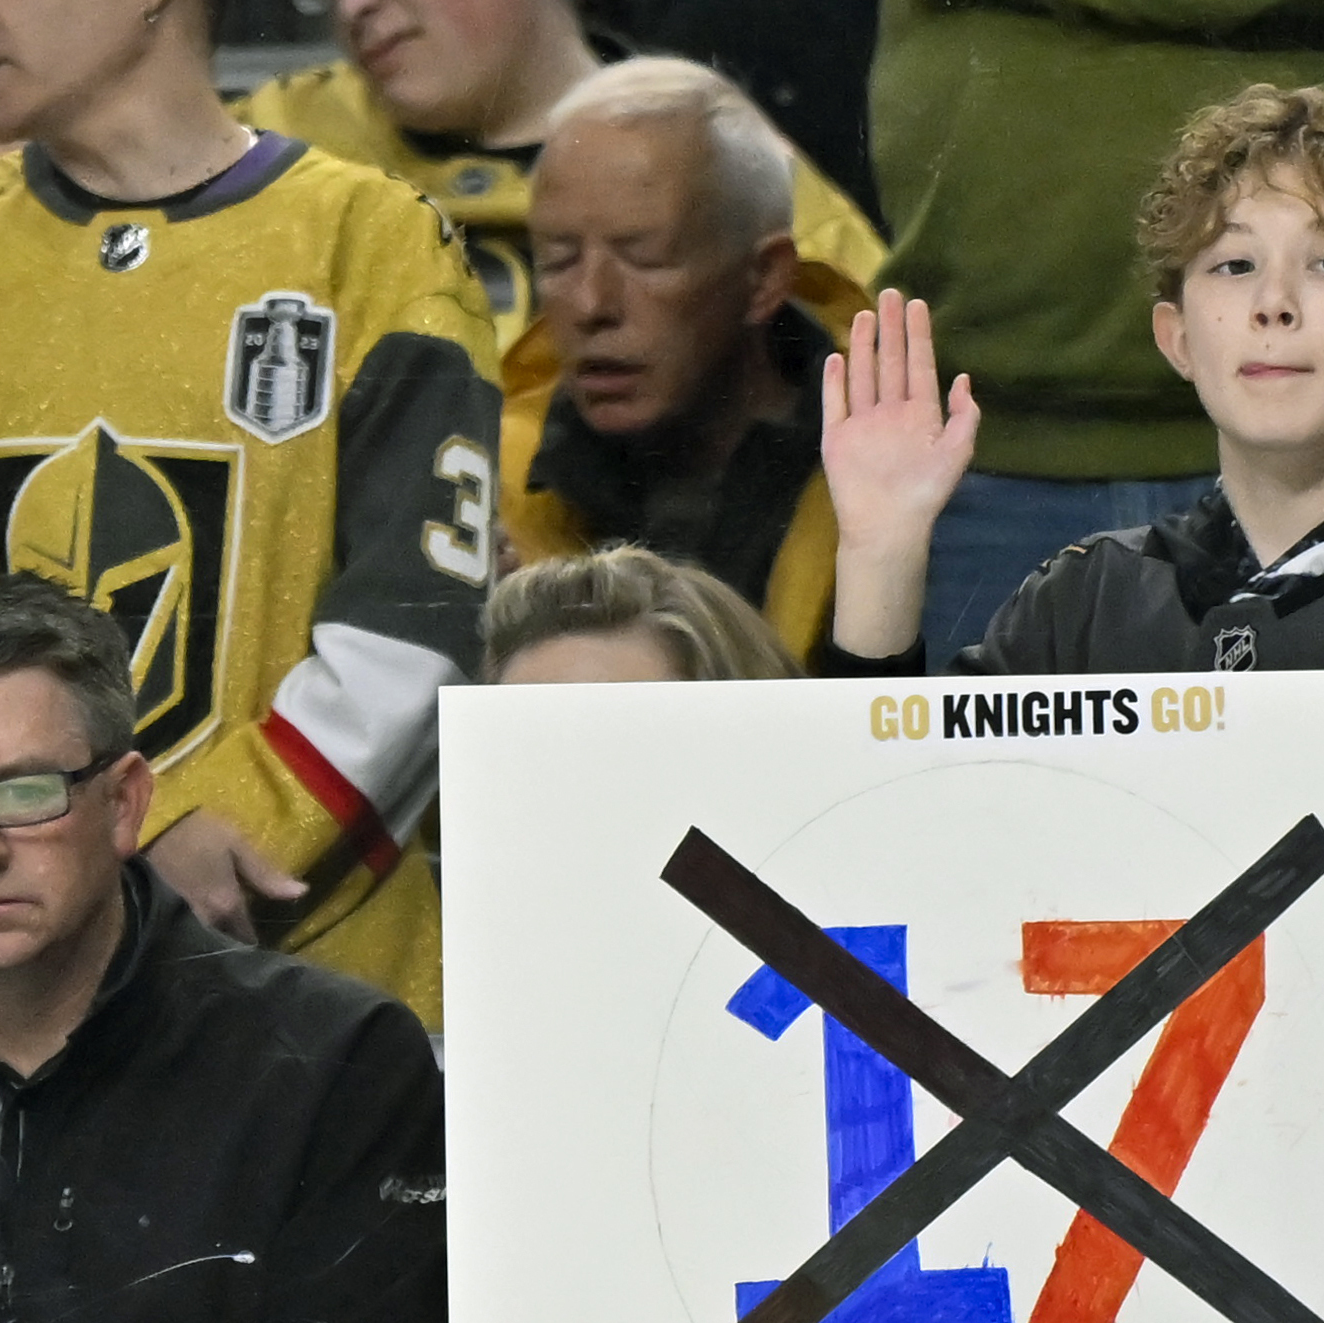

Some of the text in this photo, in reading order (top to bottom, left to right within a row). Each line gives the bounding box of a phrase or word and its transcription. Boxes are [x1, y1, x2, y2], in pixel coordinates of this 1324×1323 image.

[869, 685, 1227, 742] GO KNIGHTS GO!
